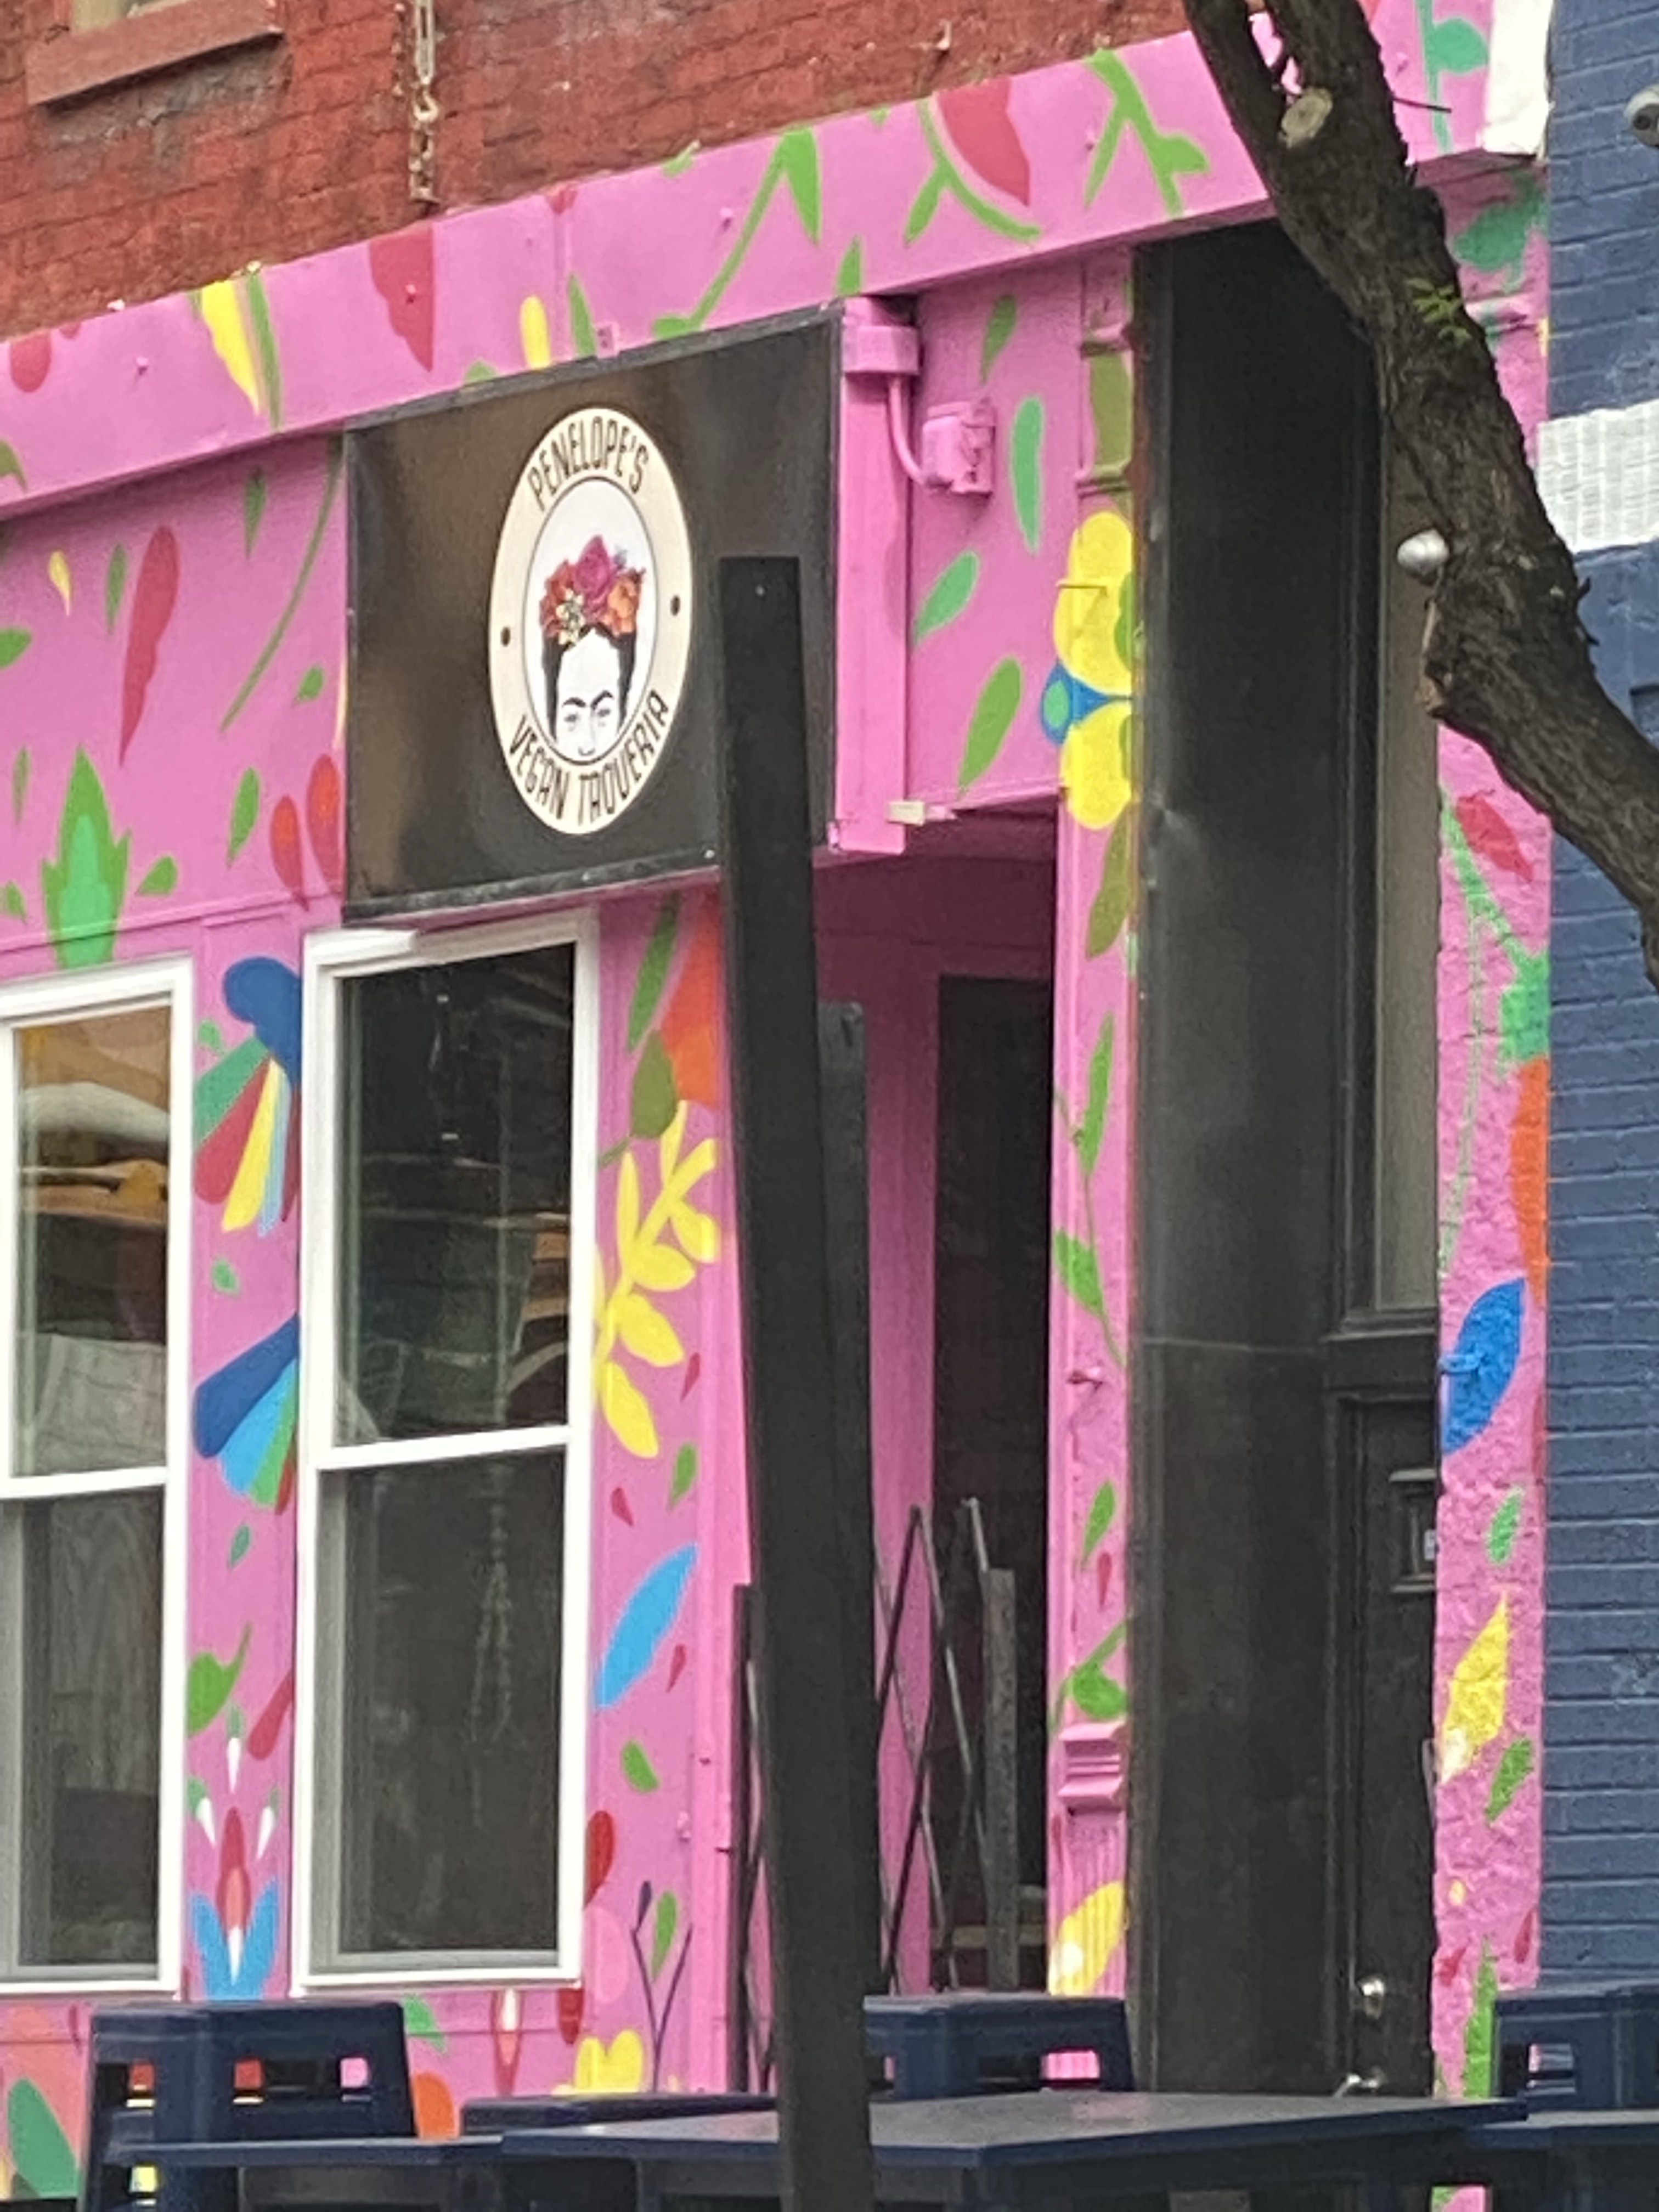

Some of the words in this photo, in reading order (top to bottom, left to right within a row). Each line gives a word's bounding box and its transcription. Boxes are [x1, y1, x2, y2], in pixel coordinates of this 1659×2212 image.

[527, 416, 649, 511] PENELOPE'S
[510, 715, 569, 820] VEGAN
[578, 690, 669, 825] TAQUERIA
